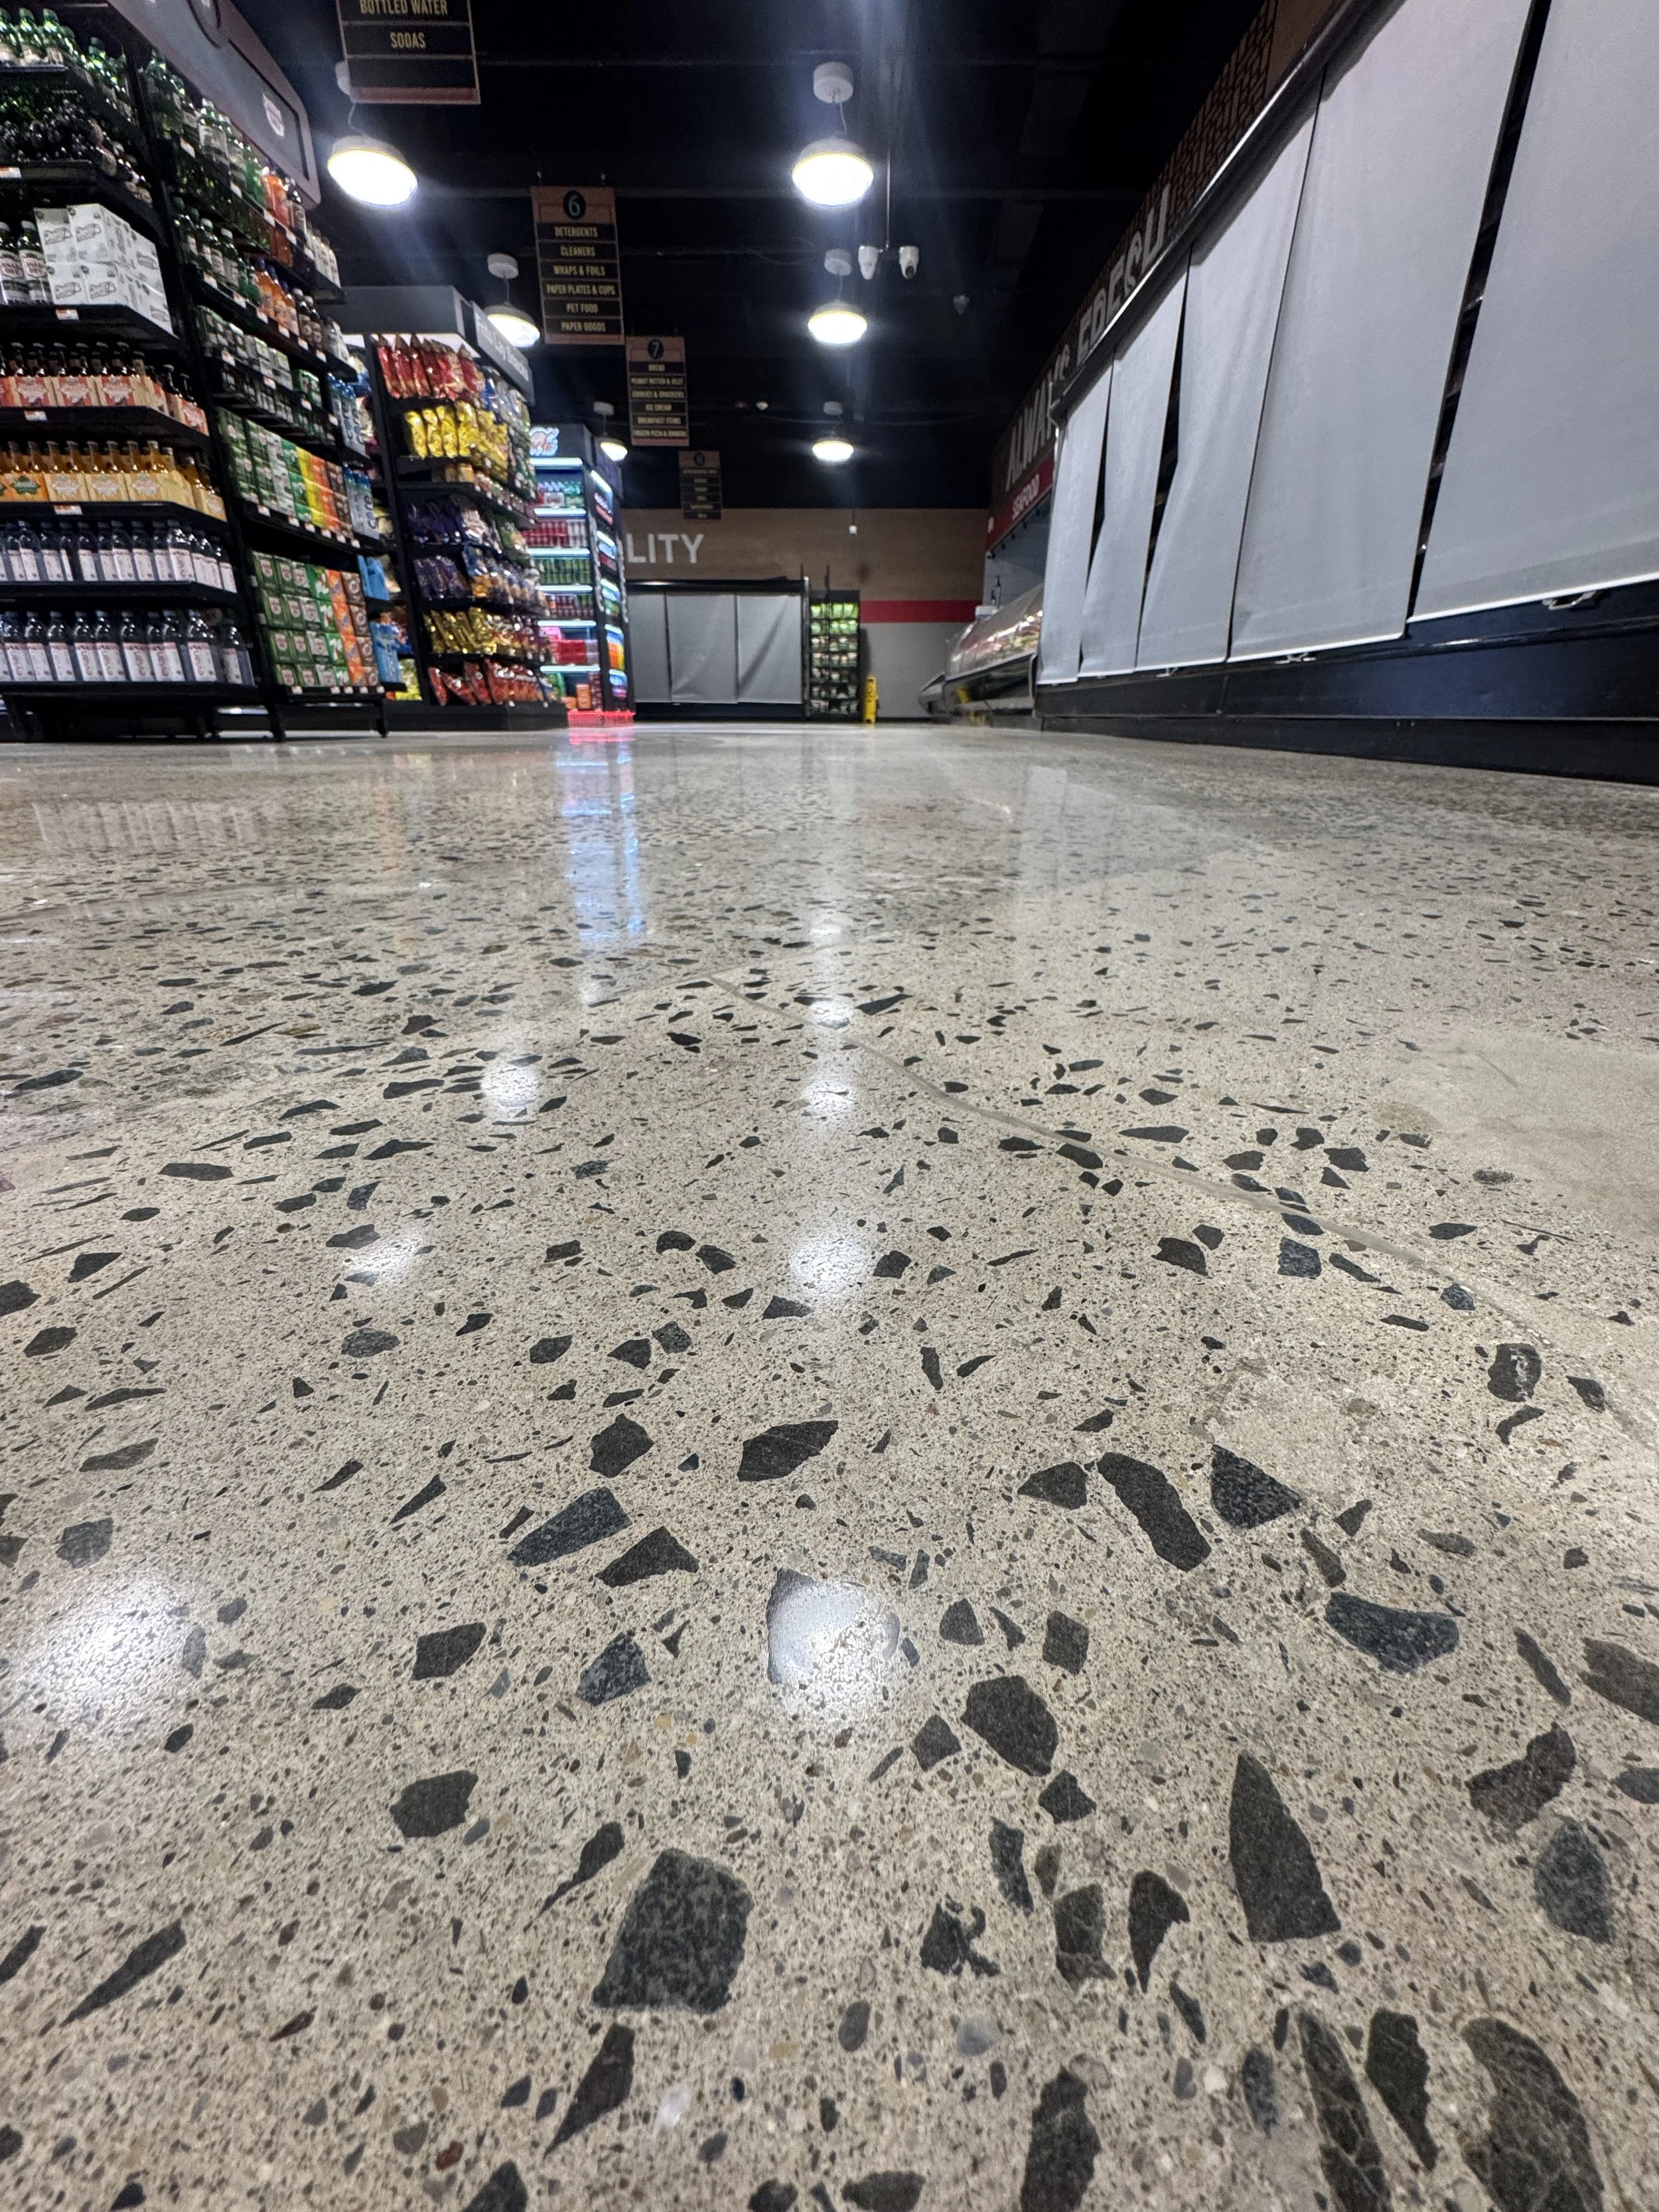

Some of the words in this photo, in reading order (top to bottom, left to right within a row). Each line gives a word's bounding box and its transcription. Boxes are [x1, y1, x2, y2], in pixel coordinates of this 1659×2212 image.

[360, 0, 408, 14] BOTTLED
[411, 0, 448, 15] WATER
[390, 32, 426, 48] SODAS
[569, 194, 581, 216] 6
[555, 226, 598, 237] DETERGENTS
[560, 245, 596, 257] CLEANERS
[546, 284, 567, 294] PAPER
[652, 342, 660, 357] 7
